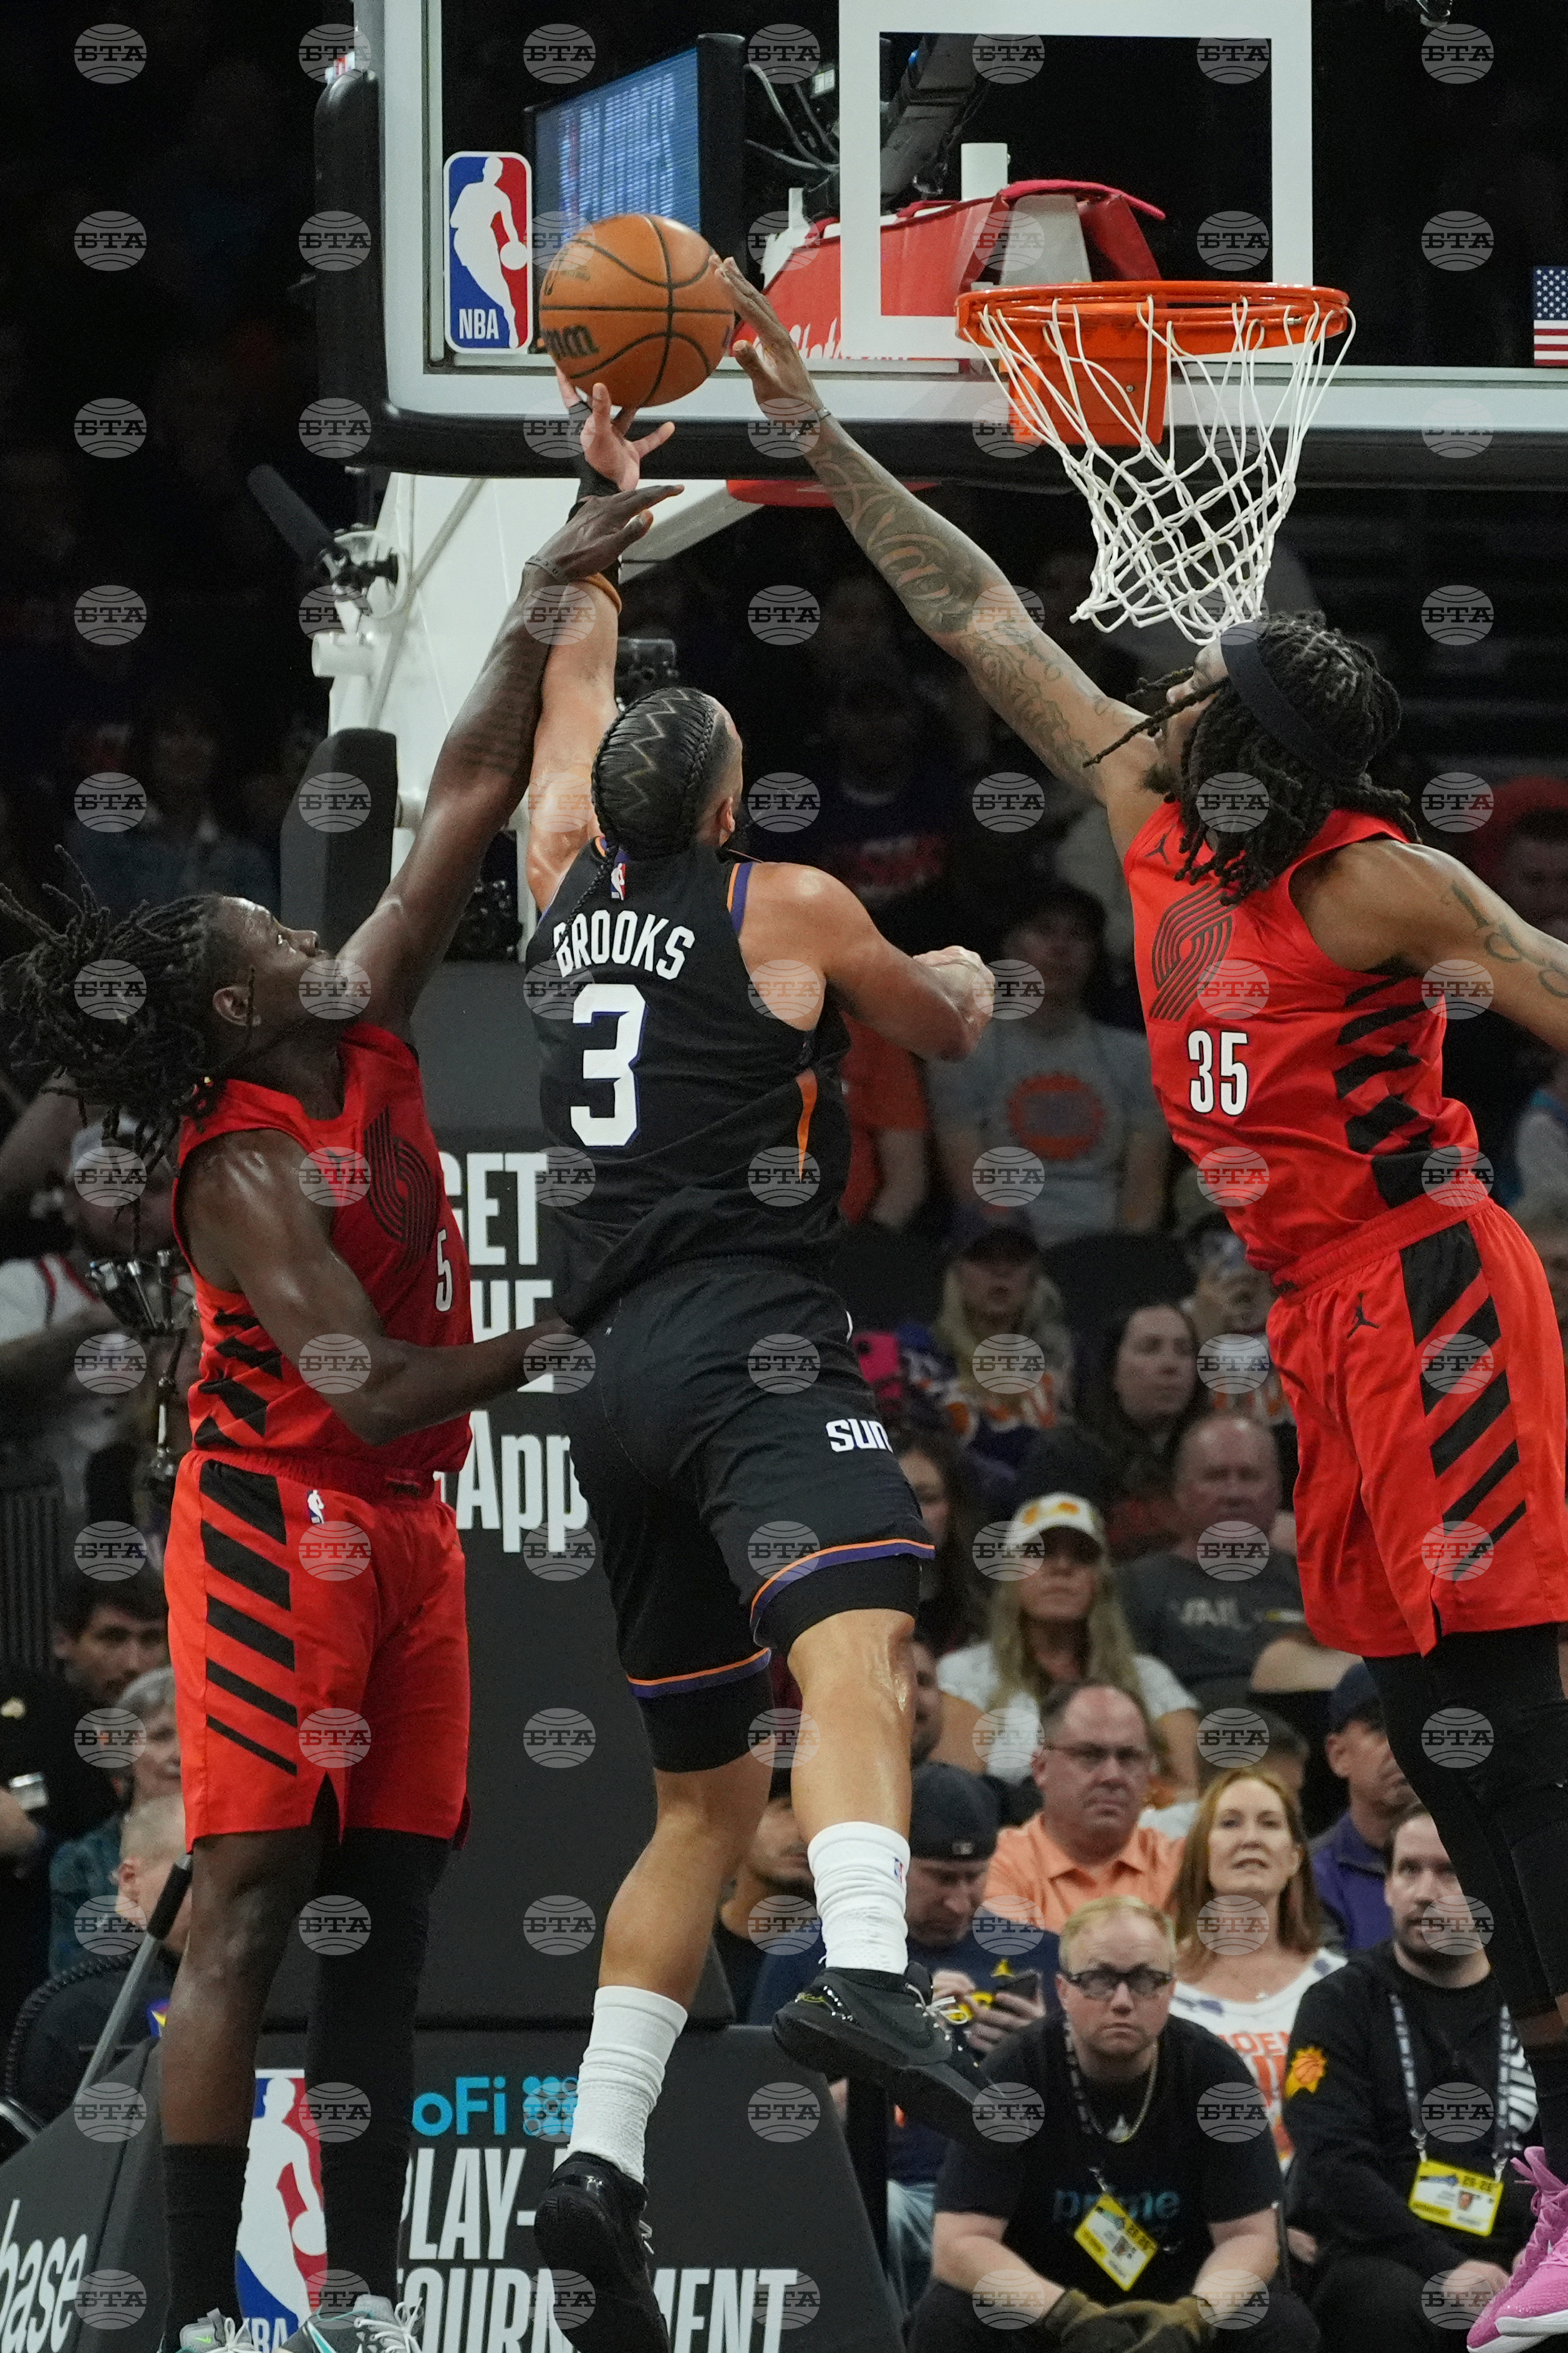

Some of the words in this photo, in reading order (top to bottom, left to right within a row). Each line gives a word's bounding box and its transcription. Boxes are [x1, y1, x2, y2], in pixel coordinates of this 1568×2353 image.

[459, 309, 499, 339] NBA
[553, 910, 695, 980] BROOKS
[571, 984, 647, 1147] 3
[1188, 1029, 1248, 1116] 35
[435, 1228, 453, 1312] 5
[456, 1410, 589, 1553] App
[412, 2076, 506, 2137] oFi
[243, 2317, 288, 2353] BA
